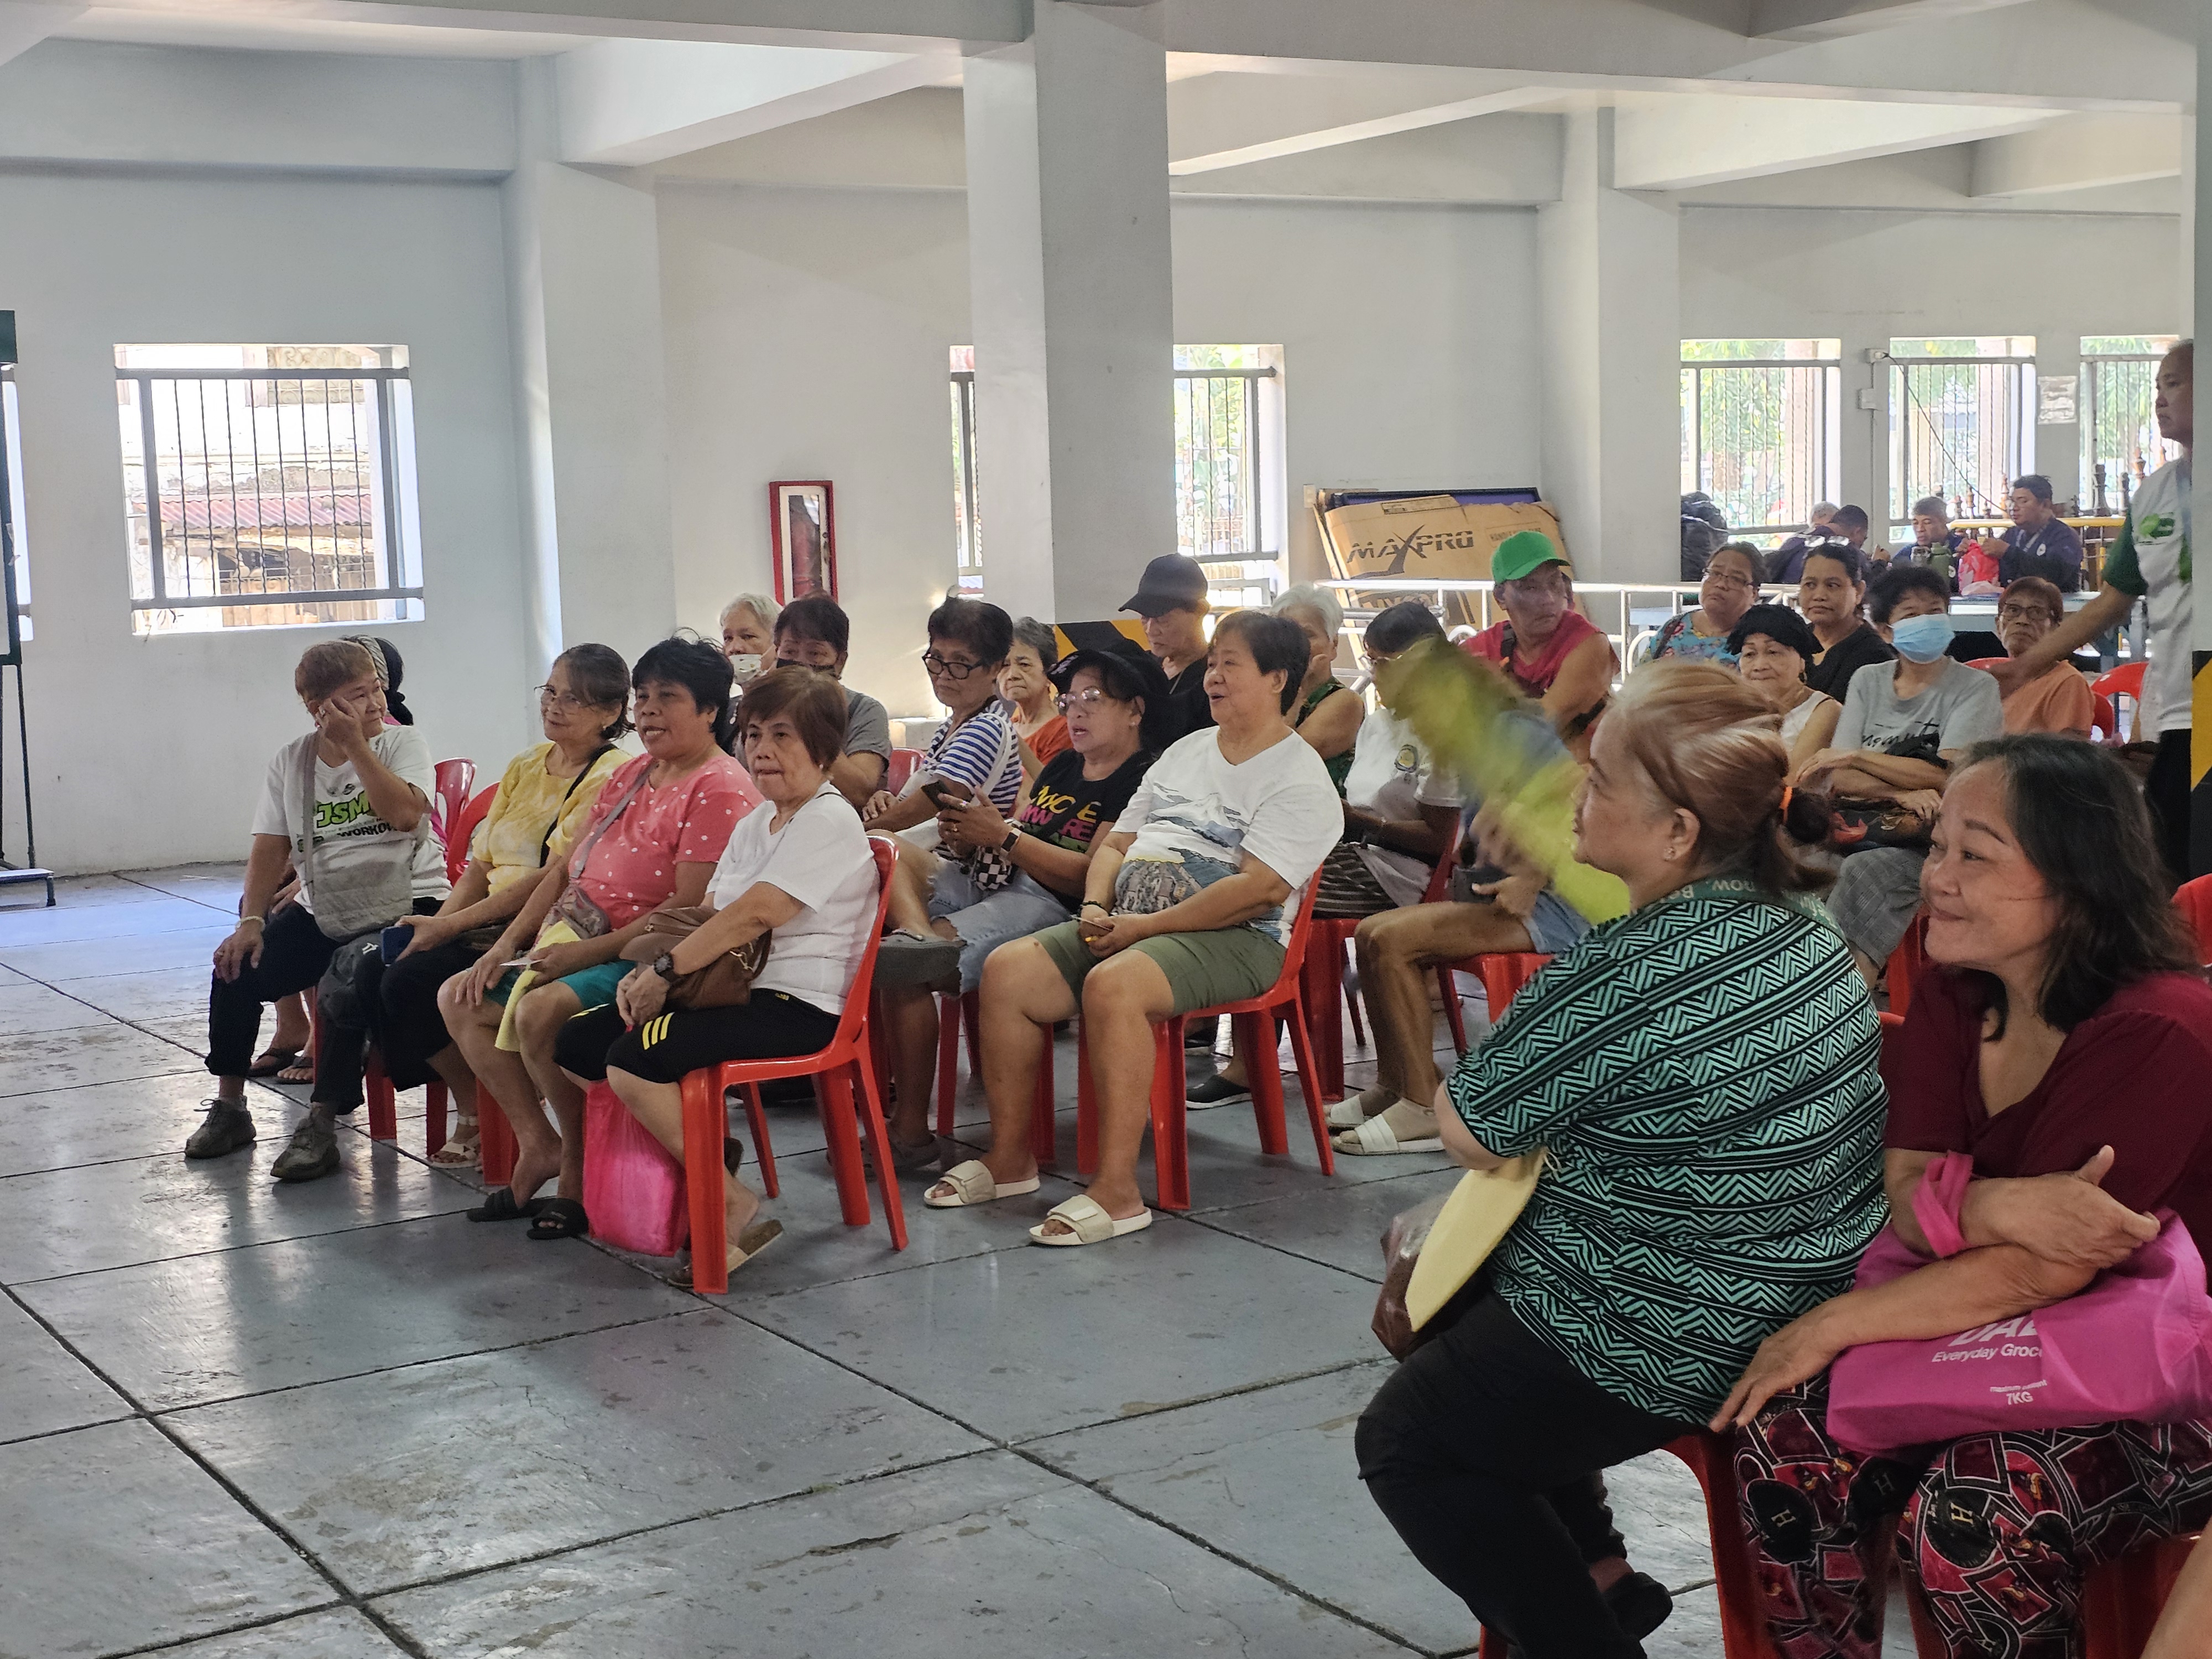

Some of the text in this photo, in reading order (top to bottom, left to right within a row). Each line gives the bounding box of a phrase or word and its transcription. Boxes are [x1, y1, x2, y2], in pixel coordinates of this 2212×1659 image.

[1346, 524, 1475, 565] MAXPRO
[1932, 1343, 2043, 1362] Everyday Groc
[2006, 1391, 2034, 1405] 7KG
